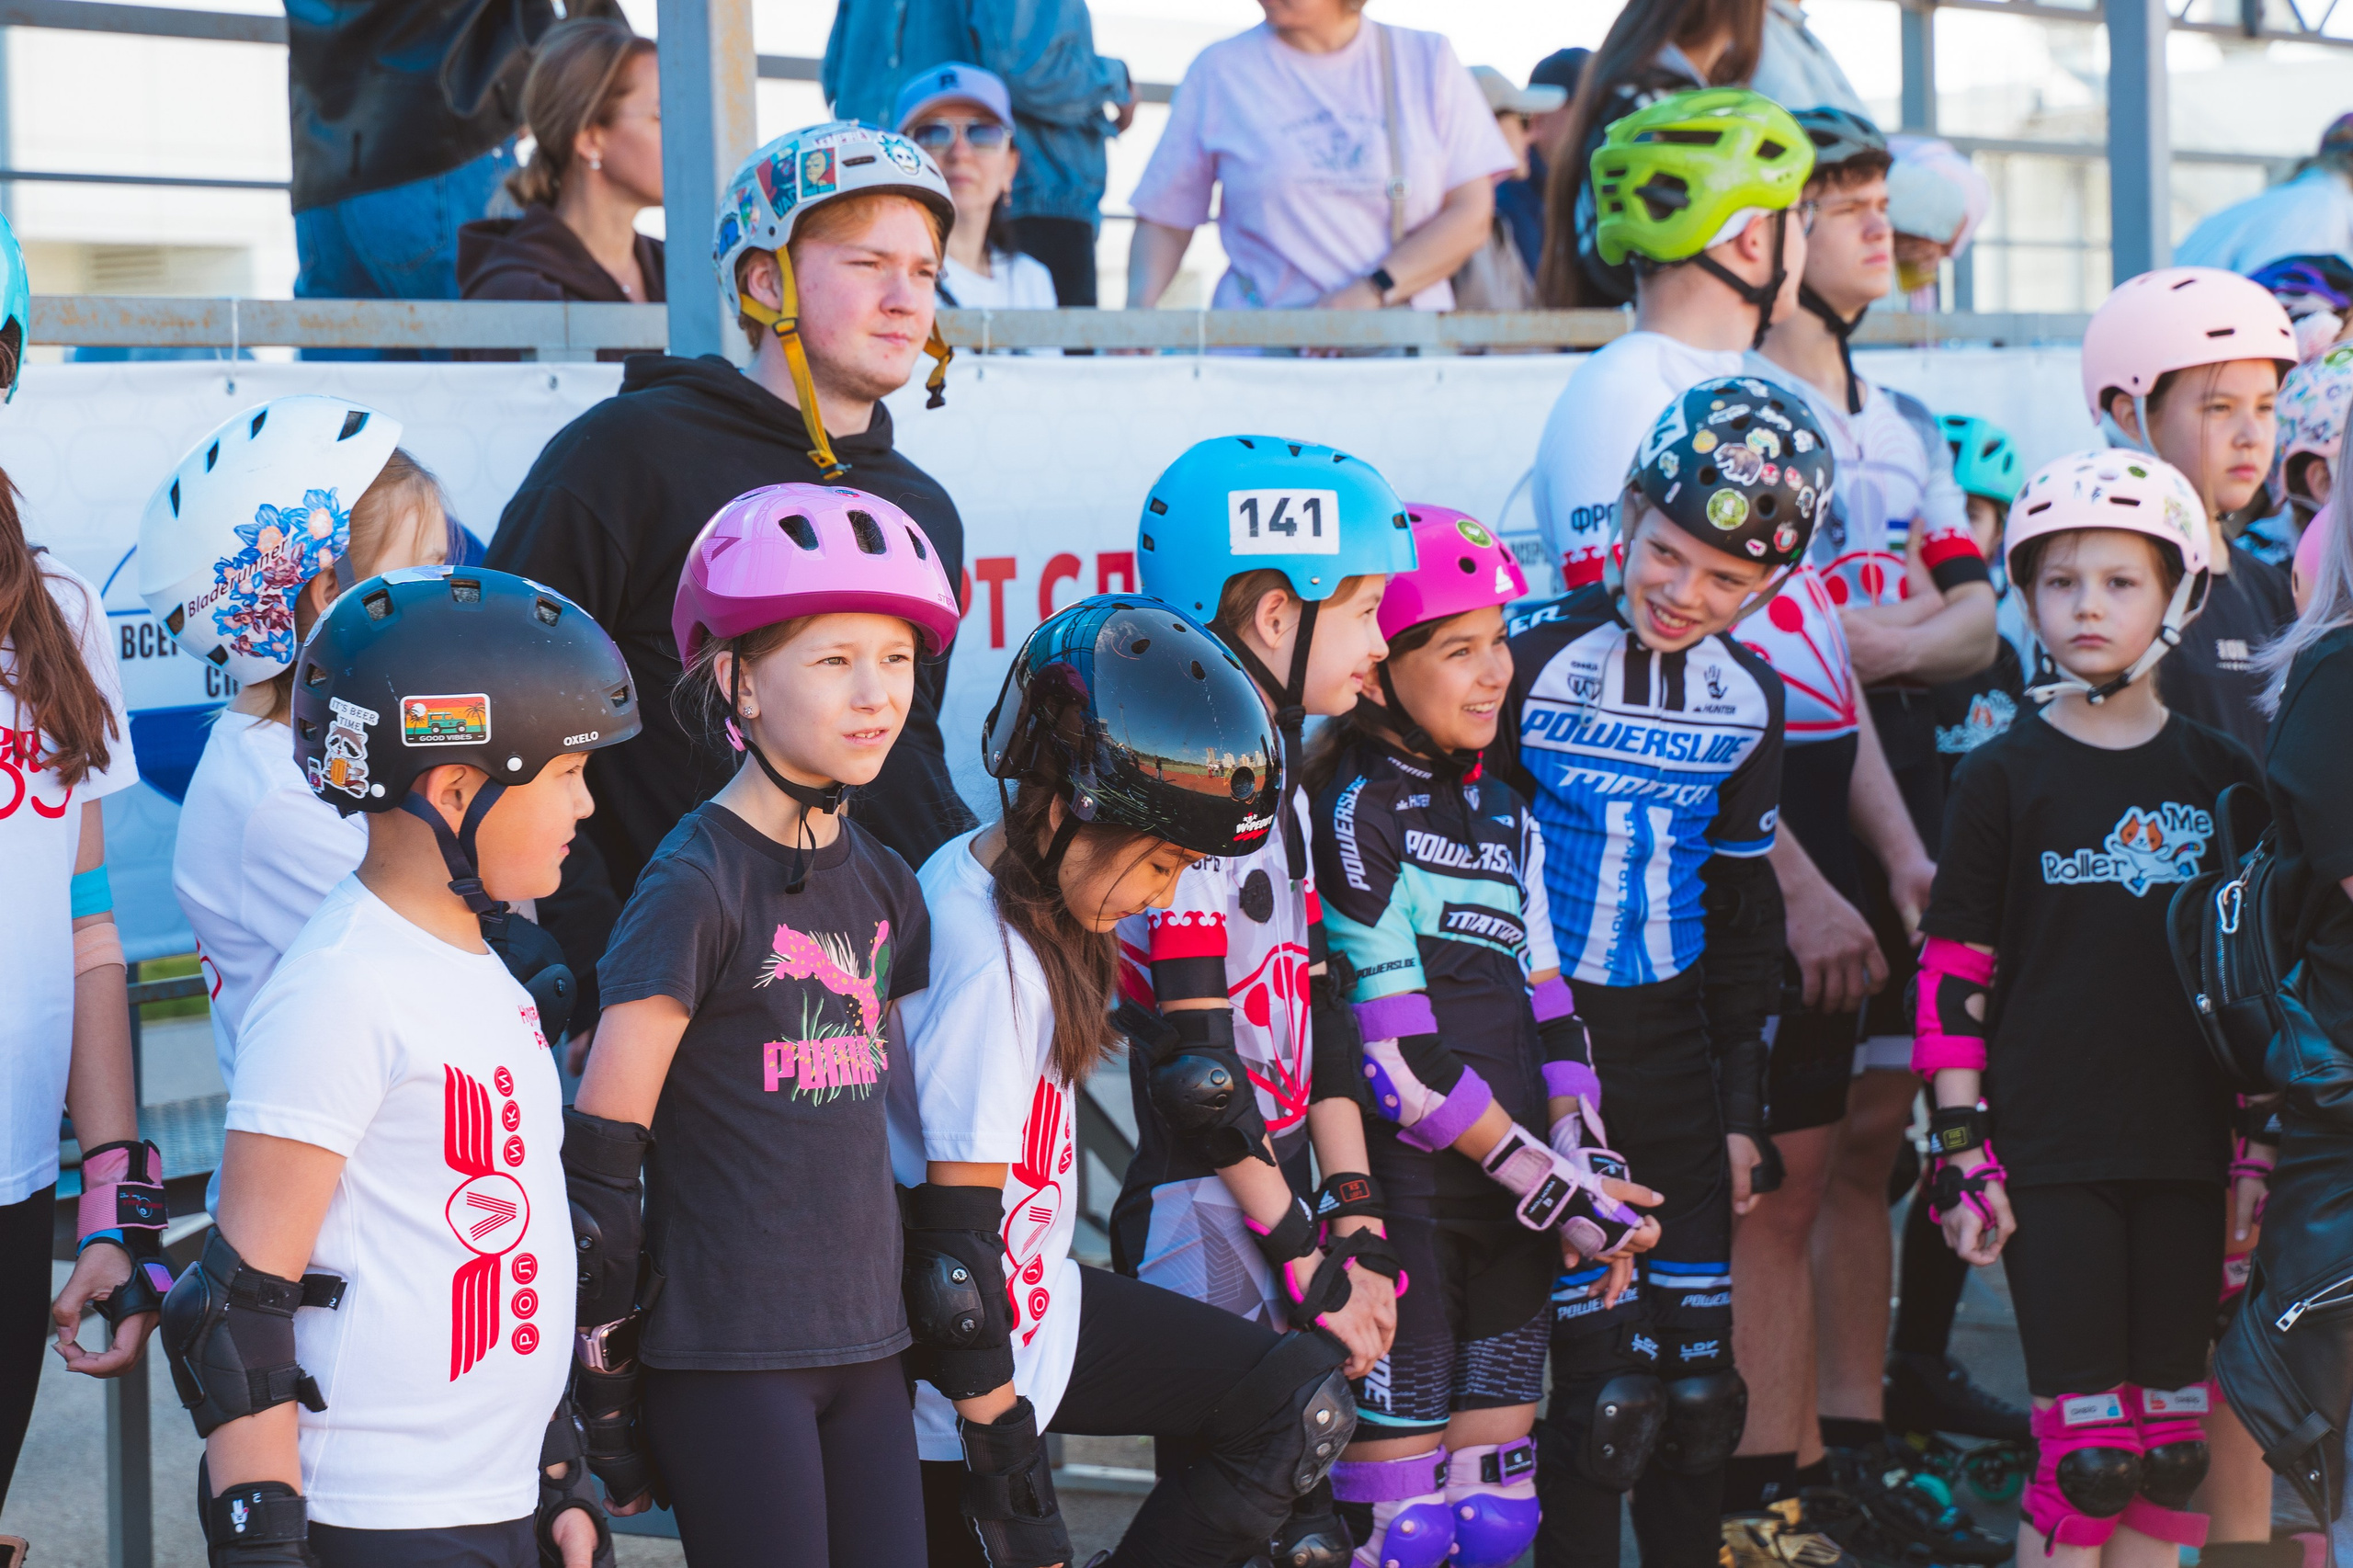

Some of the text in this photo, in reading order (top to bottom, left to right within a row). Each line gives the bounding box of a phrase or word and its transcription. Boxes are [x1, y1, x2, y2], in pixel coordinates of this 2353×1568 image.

[1240, 497, 1322, 537] 141
[188, 538, 289, 618] Bladerunner
[339, 716, 361, 732] TIME
[349, 707, 376, 723] BEER
[419, 733, 473, 743] GOOD VIBES
[563, 731, 599, 746] OXELO
[1520, 709, 1753, 765] POWERSLIDE
[2165, 808, 2211, 834] Me
[2045, 852, 2128, 880] Roller
[1355, 957, 1416, 980] POWERSLIDE
[764, 1036, 889, 1092] PUMA
